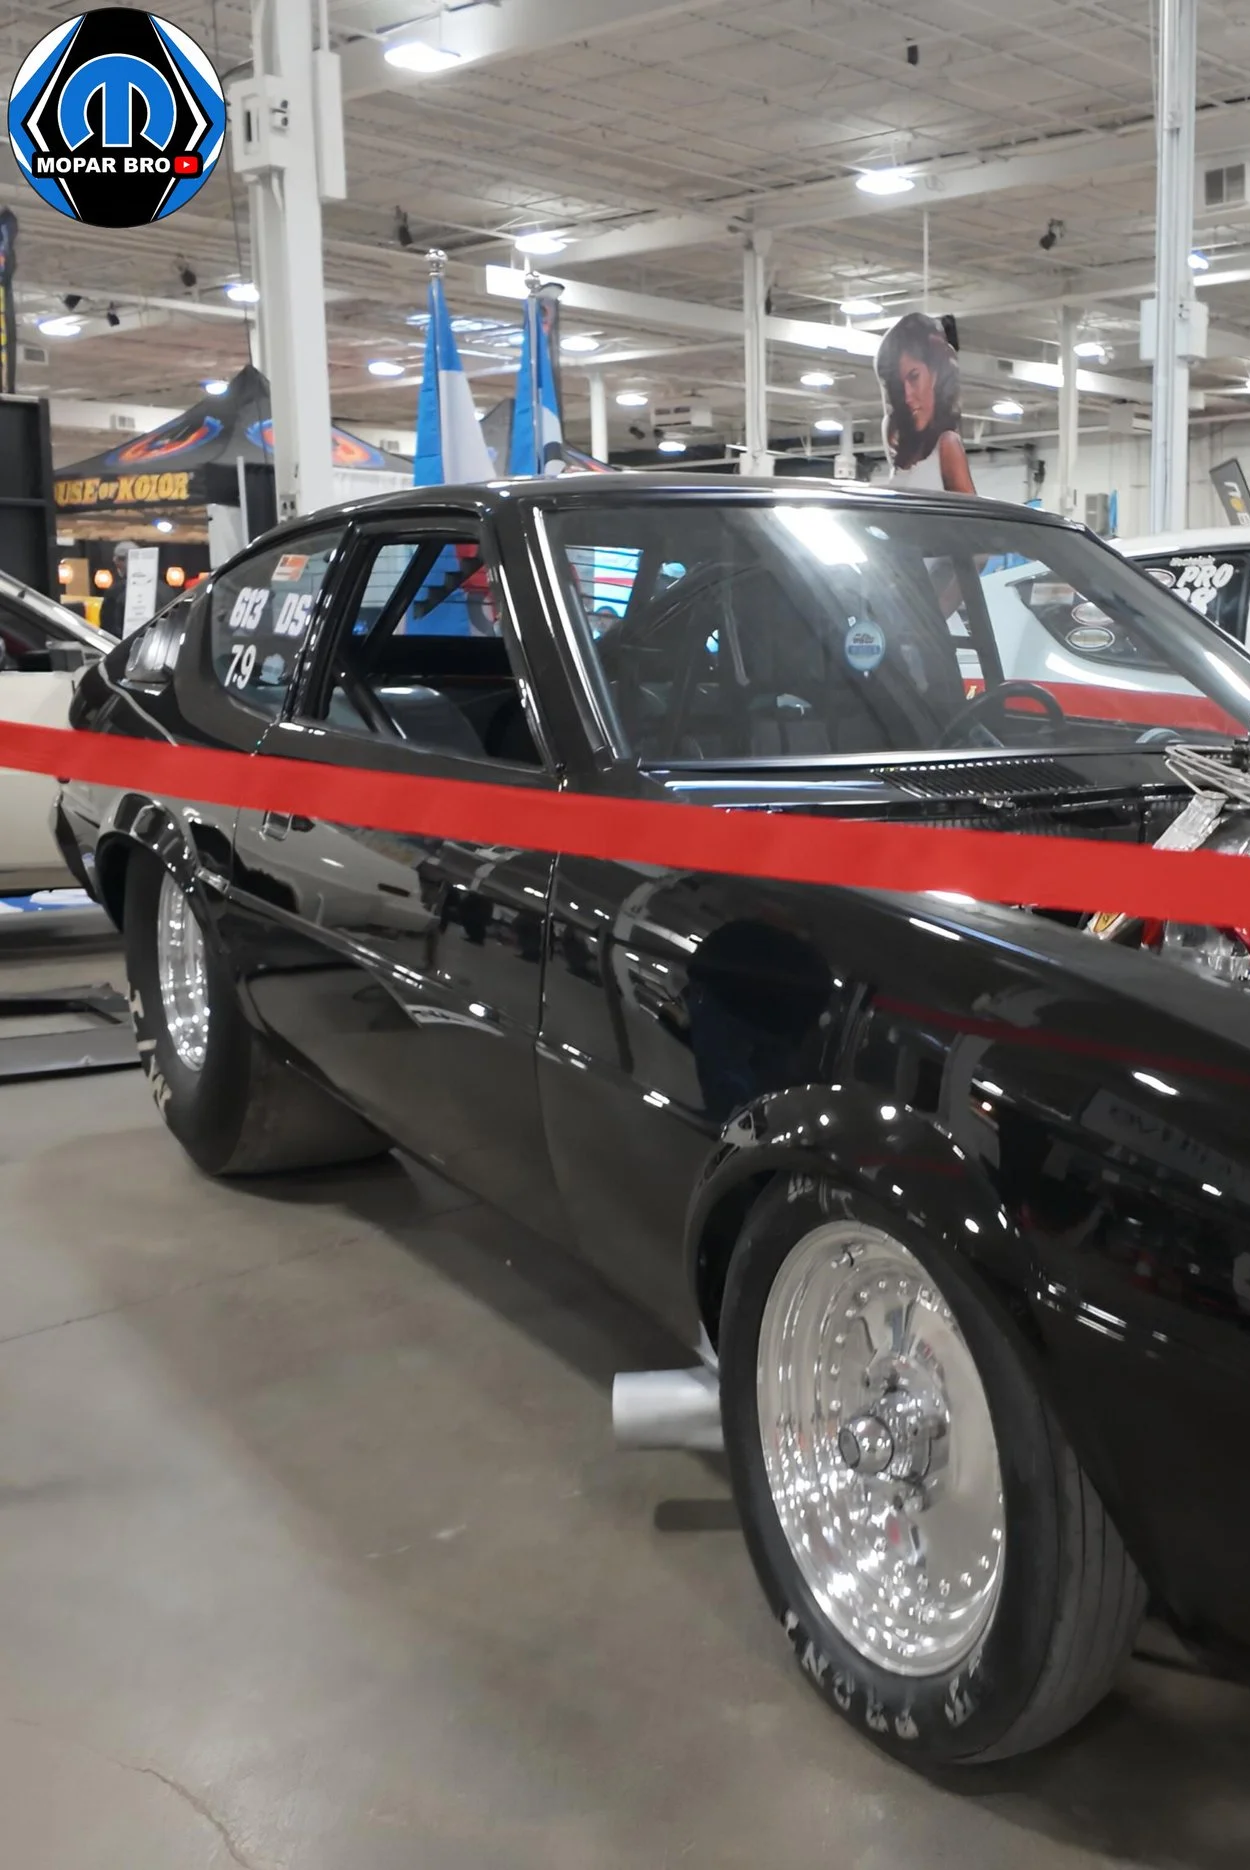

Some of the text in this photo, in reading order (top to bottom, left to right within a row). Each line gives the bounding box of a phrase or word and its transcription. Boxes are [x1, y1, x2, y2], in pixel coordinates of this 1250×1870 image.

[54, 478, 101, 507] USE
[114, 472, 189, 503] KOLOR
[1176, 563, 1234, 588] PRO
[229, 587, 269, 629] 613
[224, 644, 257, 689] 7.9
